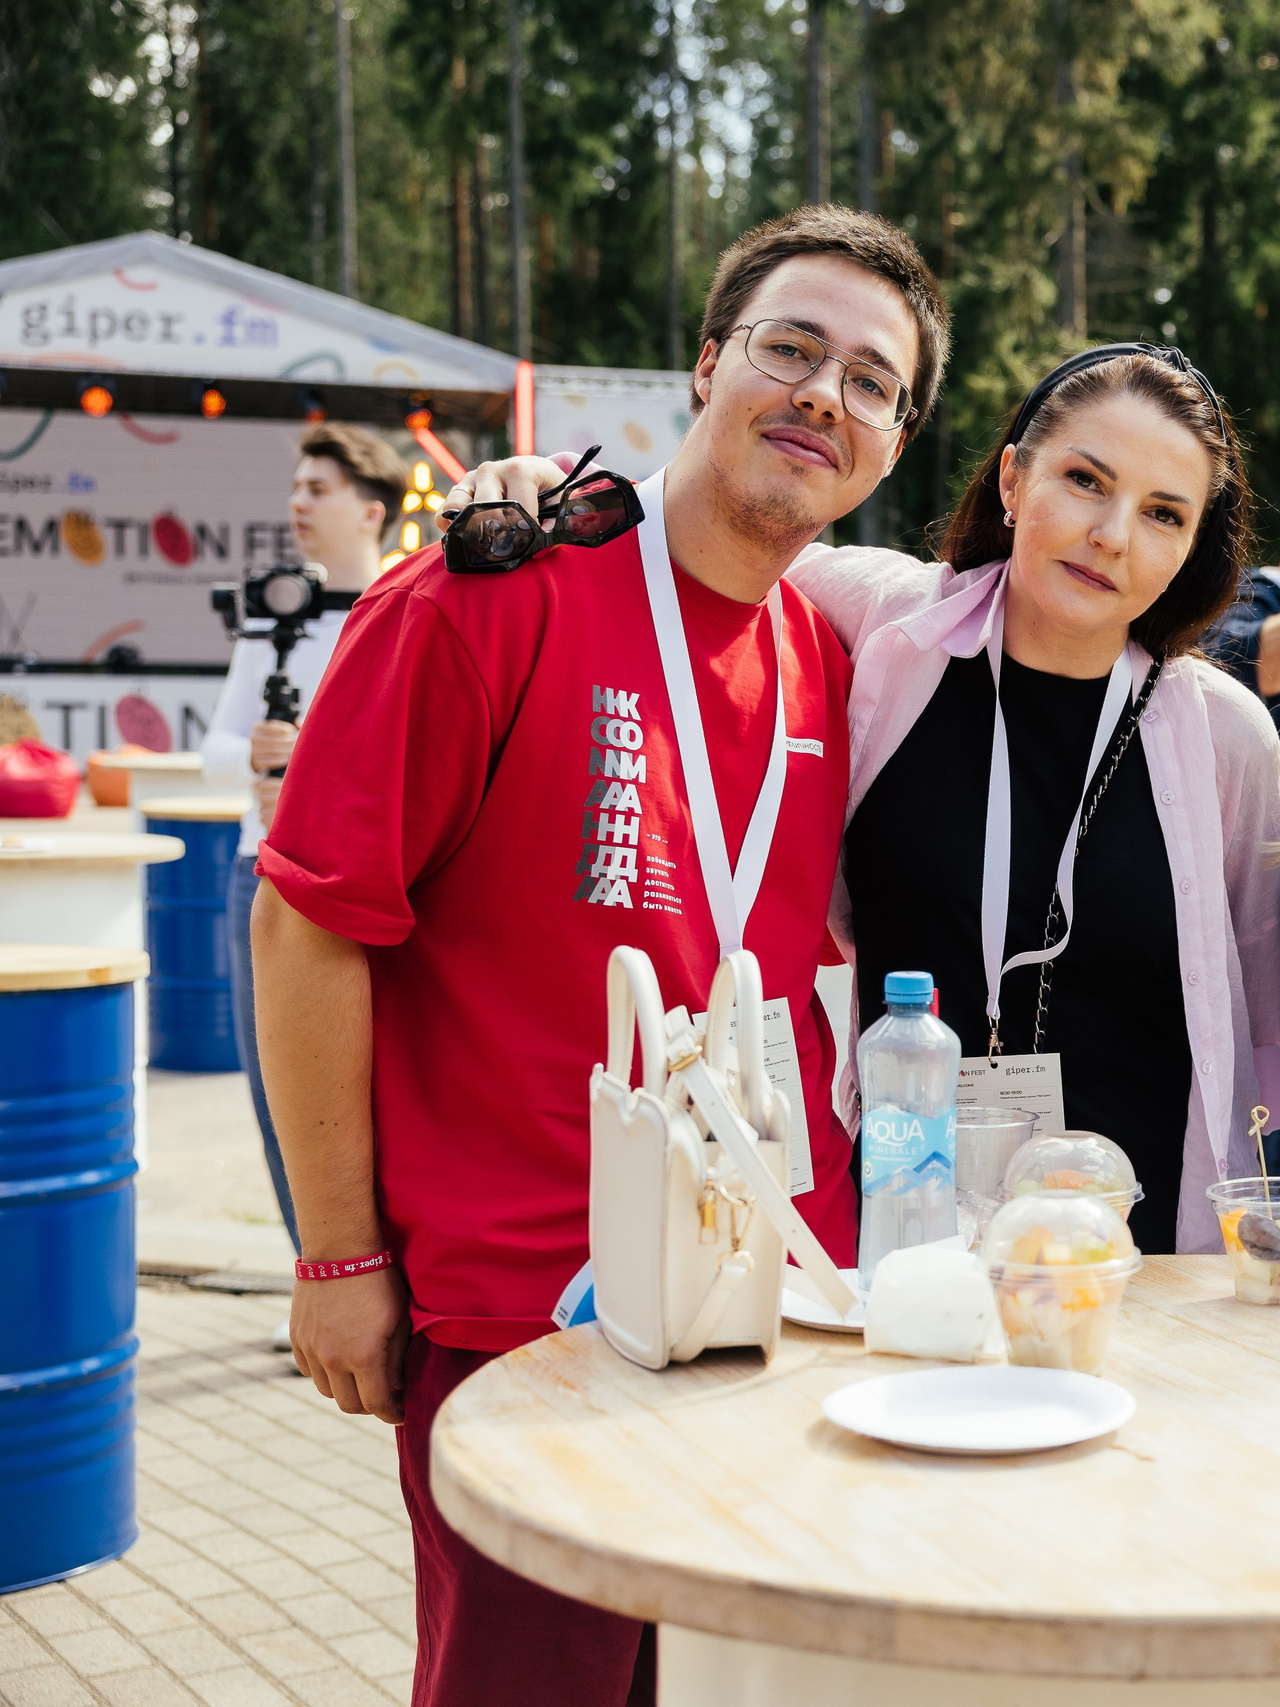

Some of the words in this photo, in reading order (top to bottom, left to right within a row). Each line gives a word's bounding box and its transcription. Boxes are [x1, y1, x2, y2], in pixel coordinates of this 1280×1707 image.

[20, 294, 279, 348] giper.fm
[646, 855, 677, 869] побеждать
[645, 867, 669, 878] звучать
[1005, 1065, 1046, 1076] giper.fm
[865, 1116, 925, 1145] AQUA
[868, 1145, 918, 1155] MINERALE
[344, 1255, 384, 1273] giper.fm
